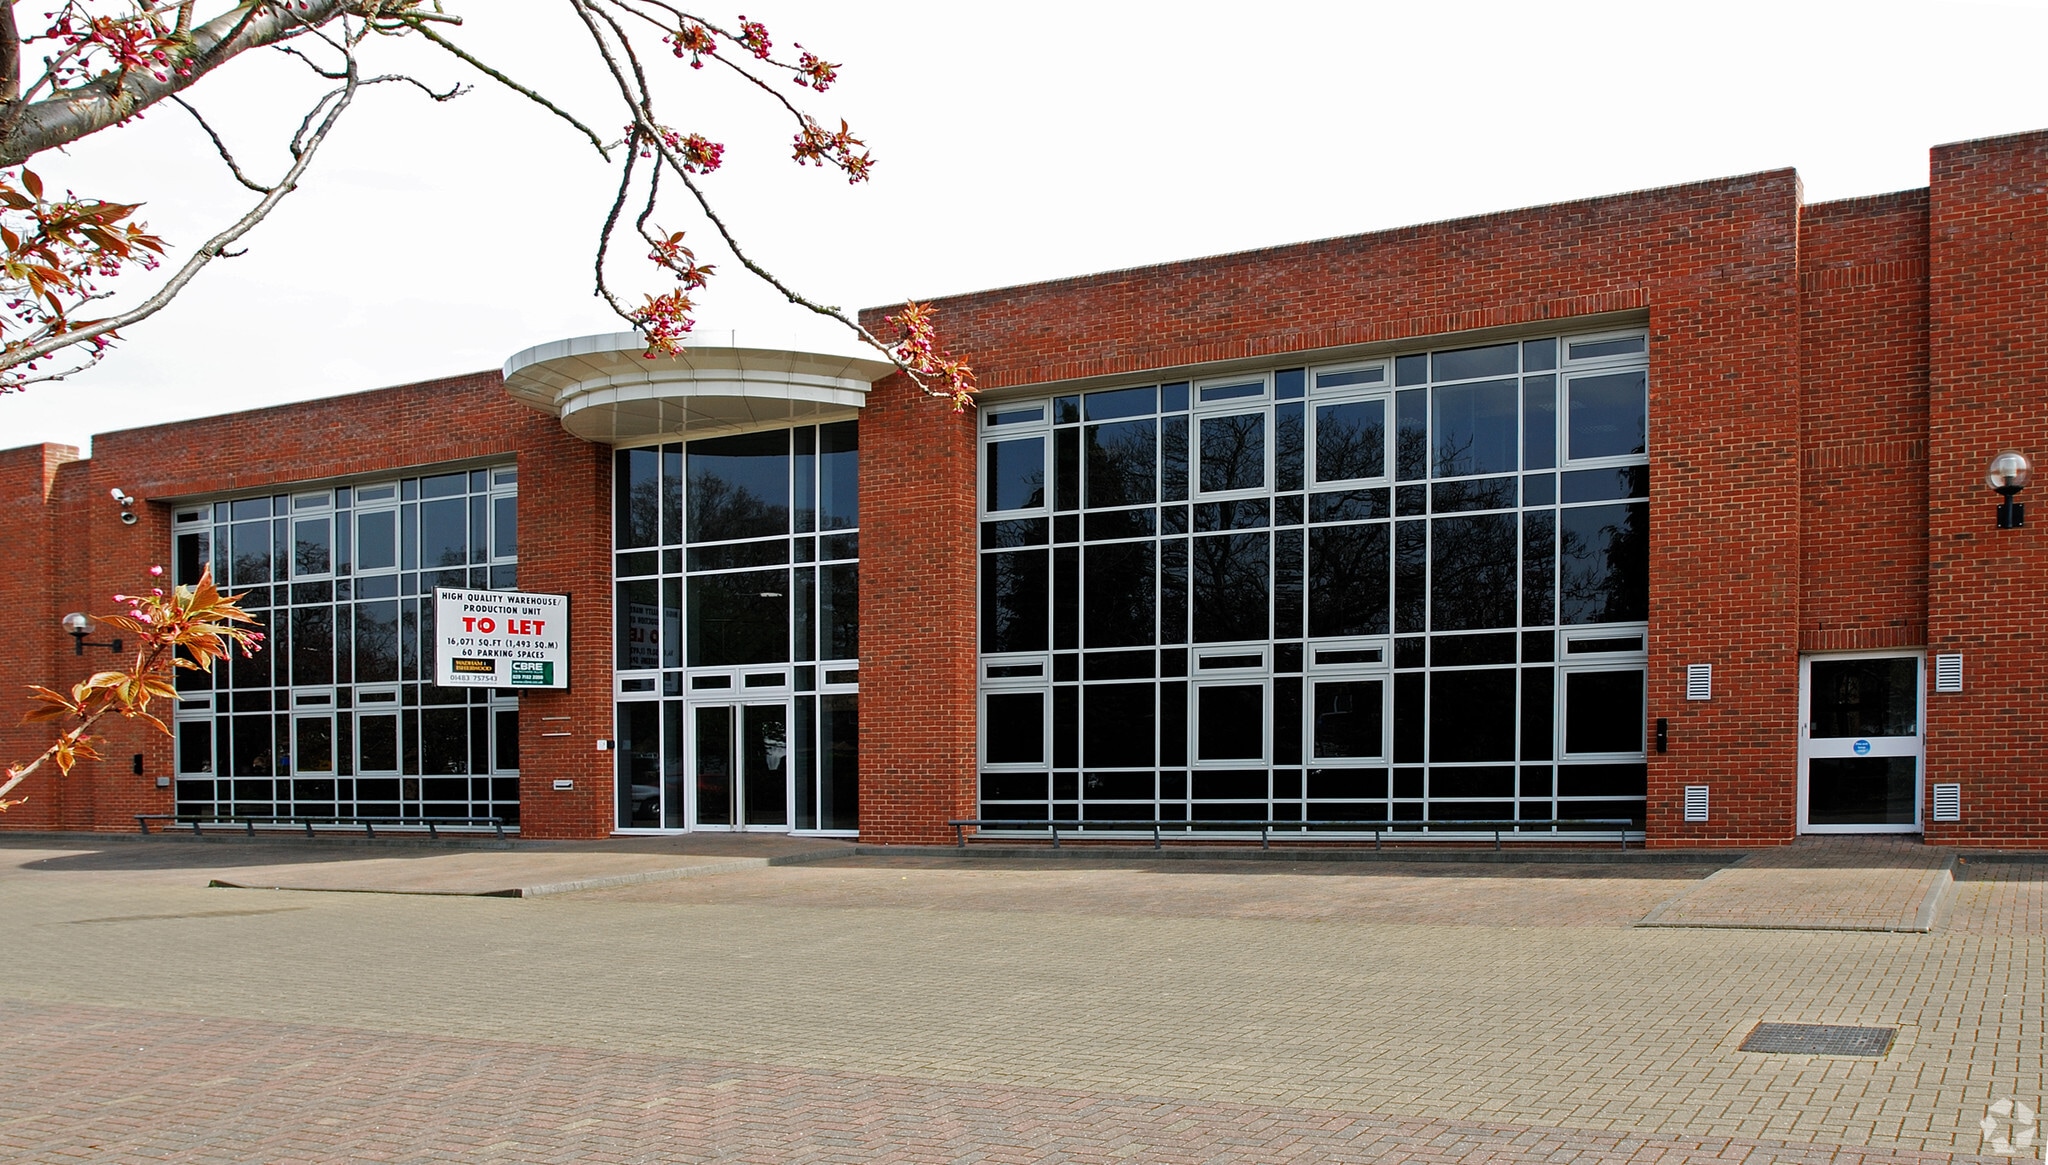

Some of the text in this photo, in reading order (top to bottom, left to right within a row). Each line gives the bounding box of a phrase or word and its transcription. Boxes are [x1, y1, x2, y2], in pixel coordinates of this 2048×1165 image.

[468, 594, 503, 602] QUALITY
[507, 596, 561, 606] WAREHOUSE/
[464, 605, 518, 614] PRODUCTION
[462, 617, 545, 635] TO LET
[448, 638, 558, 649] 16,071 SQ.FT (1,493 SQ.M)
[477, 650, 513, 658] PARKING
[513, 662, 543, 670] CBRE
